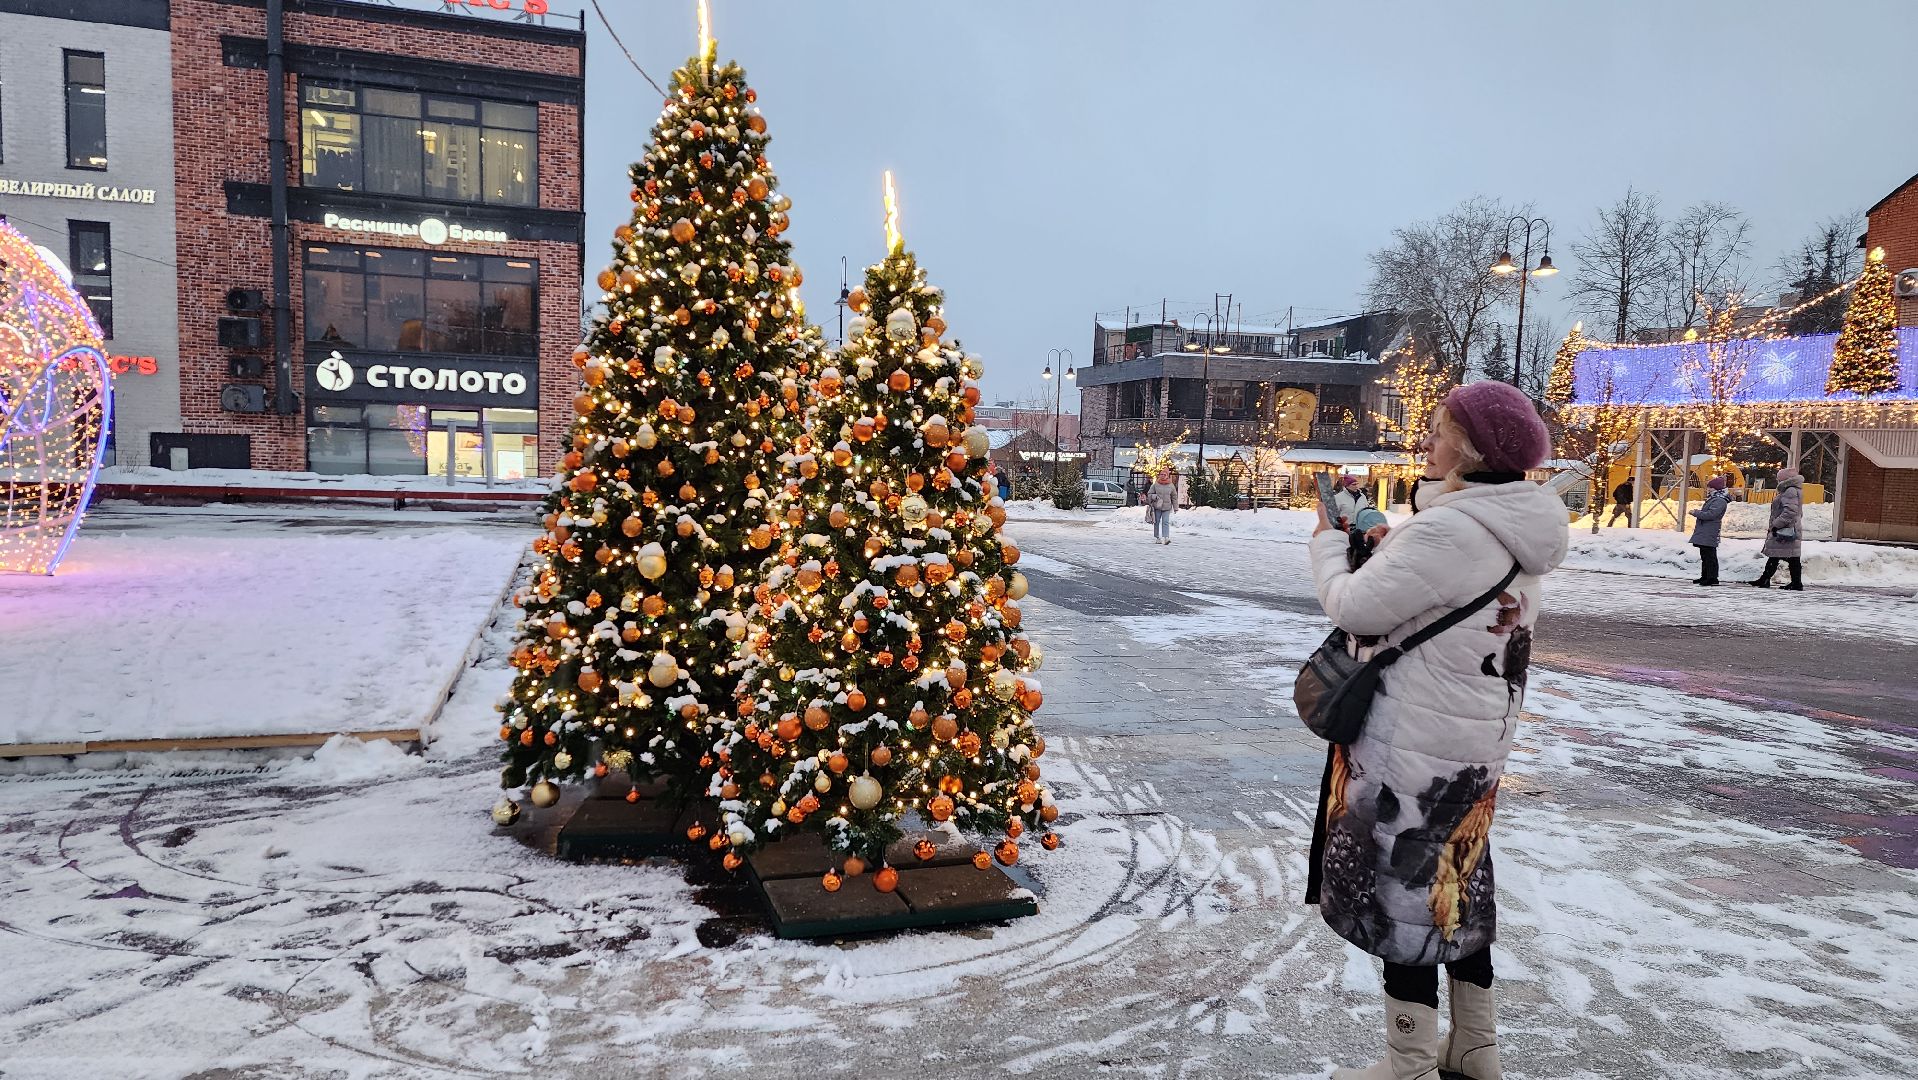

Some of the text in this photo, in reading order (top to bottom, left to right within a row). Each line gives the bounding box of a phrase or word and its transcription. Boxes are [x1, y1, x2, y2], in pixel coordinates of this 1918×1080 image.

[97, 186, 156, 204] САЛОН
[324, 213, 507, 243] Ресницы Брови
[366, 364, 527, 395] СТОЛОТО
